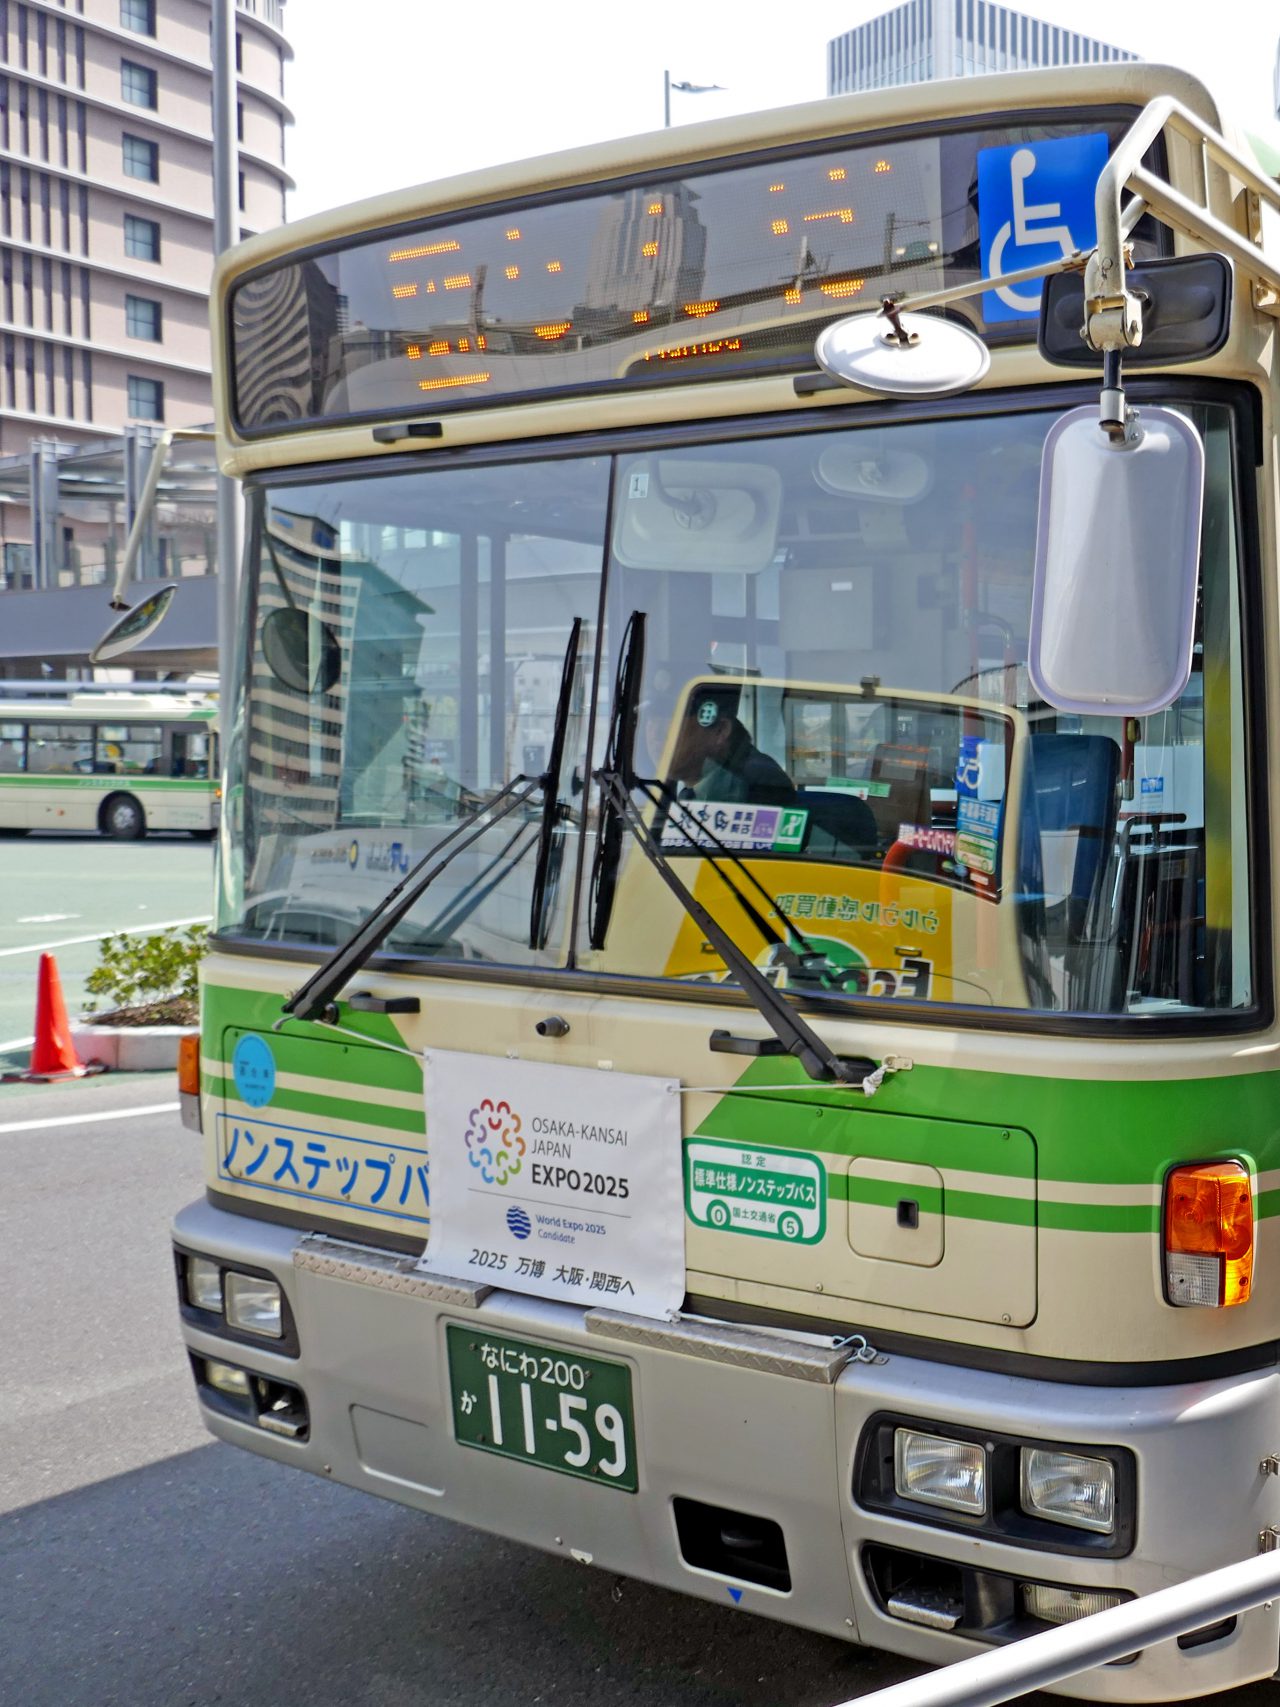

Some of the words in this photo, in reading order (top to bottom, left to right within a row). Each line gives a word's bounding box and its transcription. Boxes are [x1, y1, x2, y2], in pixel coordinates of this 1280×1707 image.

[532, 1117, 628, 1147] OSAKA-KANSAI
[531, 1140, 572, 1160] JAPAN
[741, 1153, 766, 1168] 認定
[531, 1163, 630, 1199] EXPO2025
[694, 1168, 816, 1203] 標準仕様ノンステップバス
[536, 1214, 562, 1228] World
[562, 1219, 584, 1232] Expo
[585, 1222, 607, 1235] 2025
[732, 1207, 777, 1224] 国土交通省
[786, 1221, 796, 1235] 5
[537, 1229, 576, 1245] Candidate
[468, 1248, 508, 1270] 2025
[514, 1256, 546, 1279] 万博
[460, 1390, 477, 1415] か
[488, 1373, 626, 1477] 11-59
